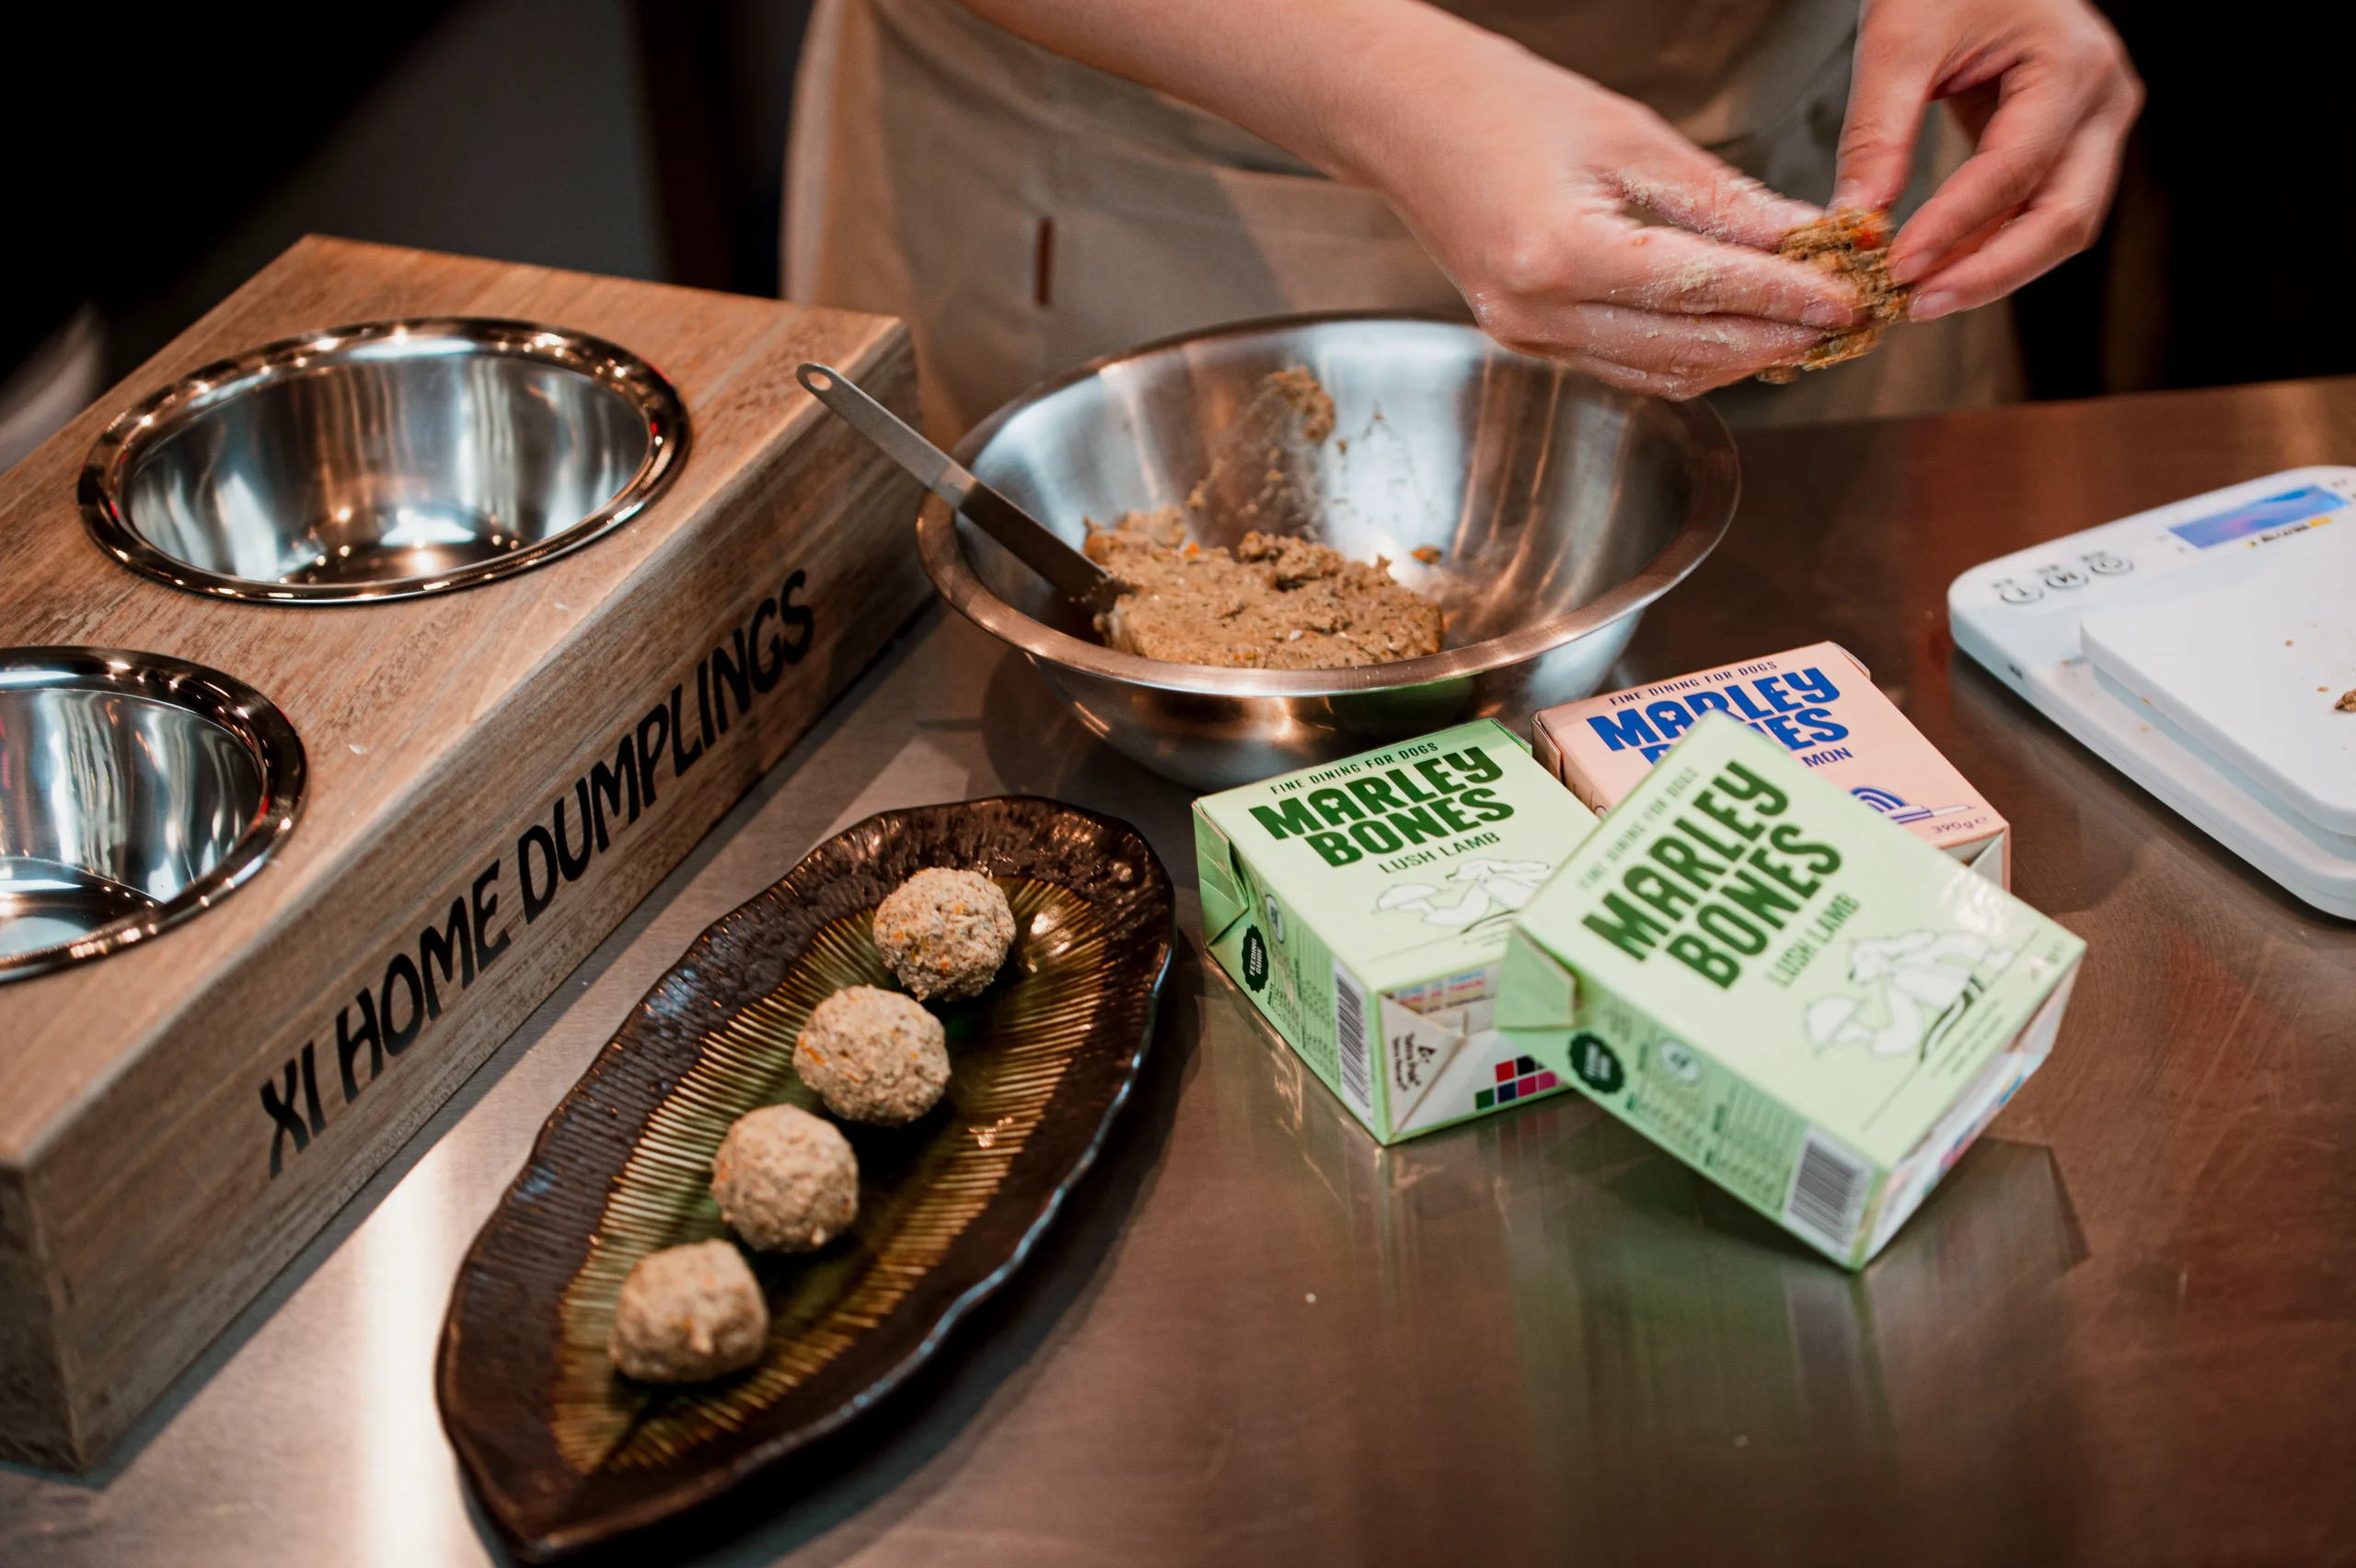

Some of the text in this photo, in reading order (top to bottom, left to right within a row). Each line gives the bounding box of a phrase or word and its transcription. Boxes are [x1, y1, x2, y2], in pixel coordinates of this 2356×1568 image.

[1586, 667, 1841, 752] MARLEY
[1609, 662, 1778, 706] FINE DINING FOR DOGS
[1248, 746, 1504, 841] MARLEY
[1270, 743, 1438, 795] FINE DINING FOR DOGS
[1304, 788, 1514, 868] BONES
[1378, 832, 1501, 874] LUSH LAMB
[1581, 759, 1790, 963] MARLEY
[260, 570, 814, 1179] XI HOME DUMPLINGS
[1665, 824, 1843, 990] BONES
[1249, 938, 1258, 976] FEEDING
[1766, 892, 1860, 987] LUSH LAMB
